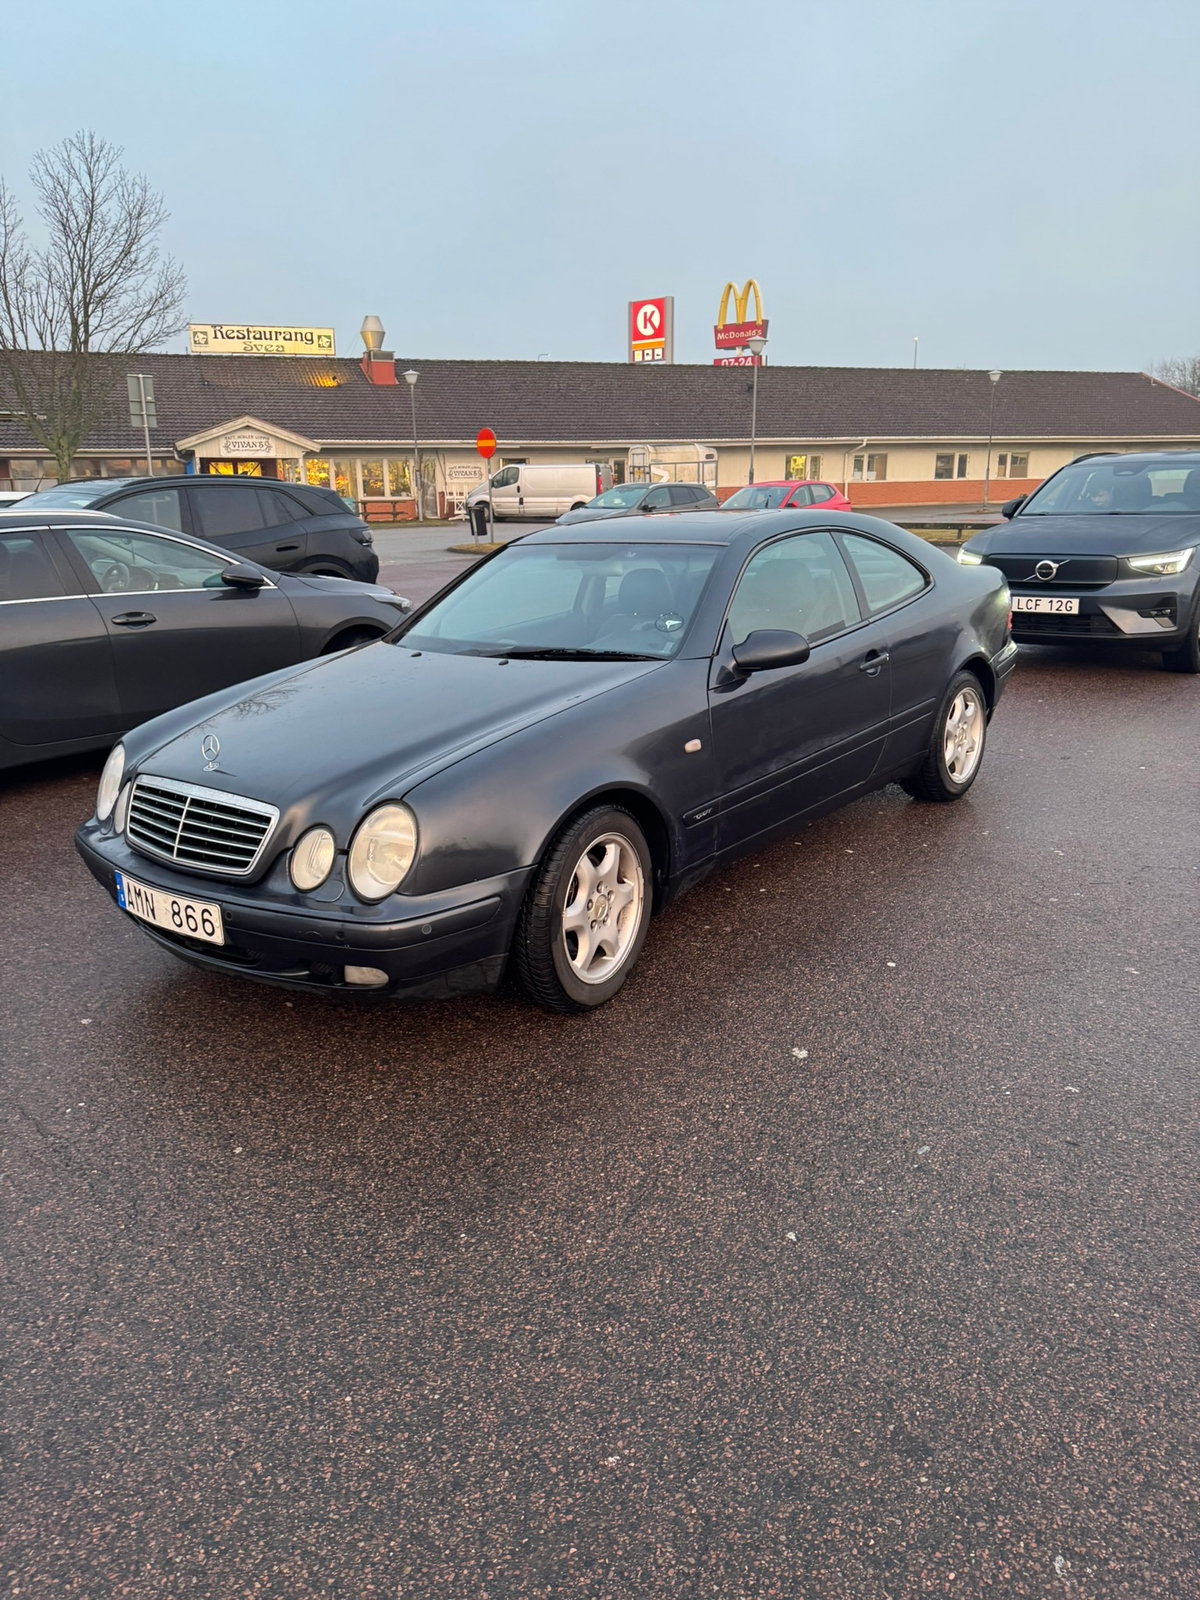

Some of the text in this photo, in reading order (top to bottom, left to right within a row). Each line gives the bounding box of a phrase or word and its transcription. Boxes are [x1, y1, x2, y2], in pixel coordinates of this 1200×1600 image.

[641, 308, 660, 334] K
[211, 325, 314, 345] Restaurang
[717, 329, 762, 340] McDonald's
[243, 341, 285, 352] Svea
[1017, 598, 1073, 612] LCF 12G
[126, 881, 216, 937] AMN 866
